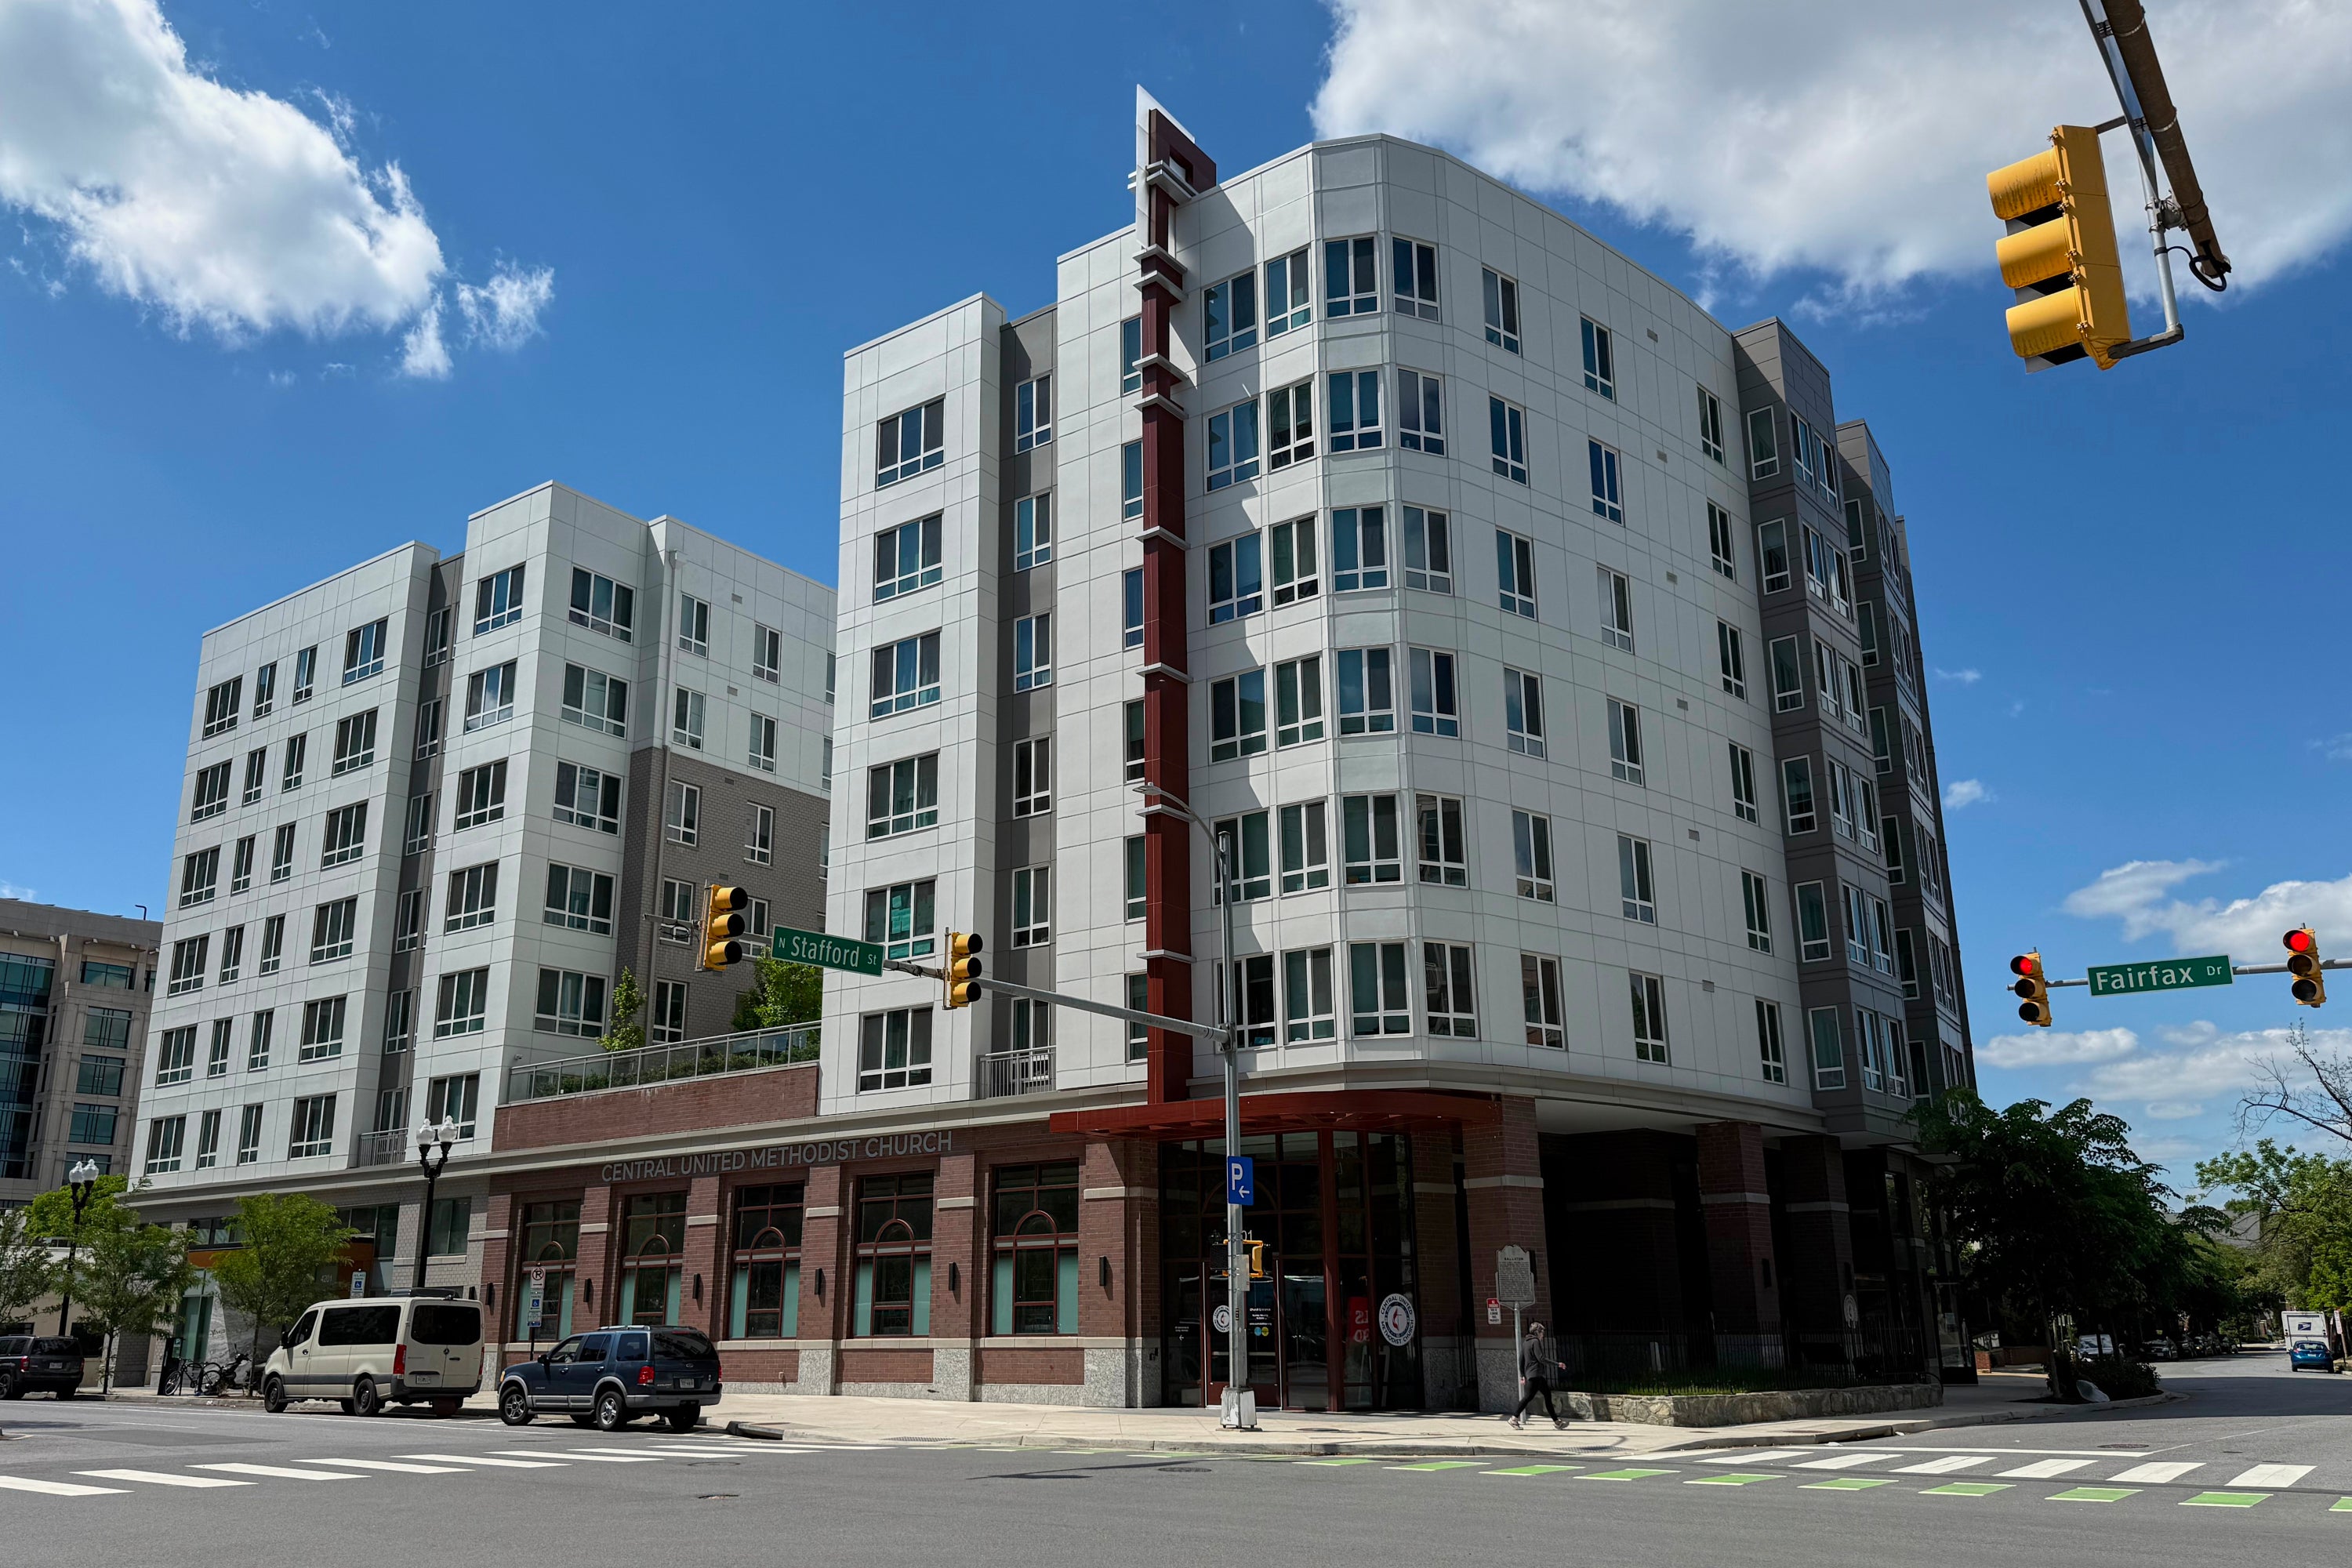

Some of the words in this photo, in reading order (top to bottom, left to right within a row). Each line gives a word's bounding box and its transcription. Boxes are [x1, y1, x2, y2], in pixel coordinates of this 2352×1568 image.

[779, 937, 786, 949] N
[790, 935, 860, 967] Stafford
[867, 953, 877, 965] St
[2096, 965, 2194, 991] Fairfax
[2206, 965, 2222, 976] Dr
[601, 1157, 676, 1182] CENTRAL
[681, 1150, 746, 1175] UNITED
[750, 1139, 860, 1168] METHODIST
[865, 1131, 953, 1158] CHURCH
[1231, 1163, 1243, 1191] P
[1381, 1295, 1398, 1315] CENTRAL
[1399, 1296, 1413, 1315] UNITED
[1381, 1321, 1402, 1344] METHODIST
[1403, 1319, 1414, 1341] CHURCH
